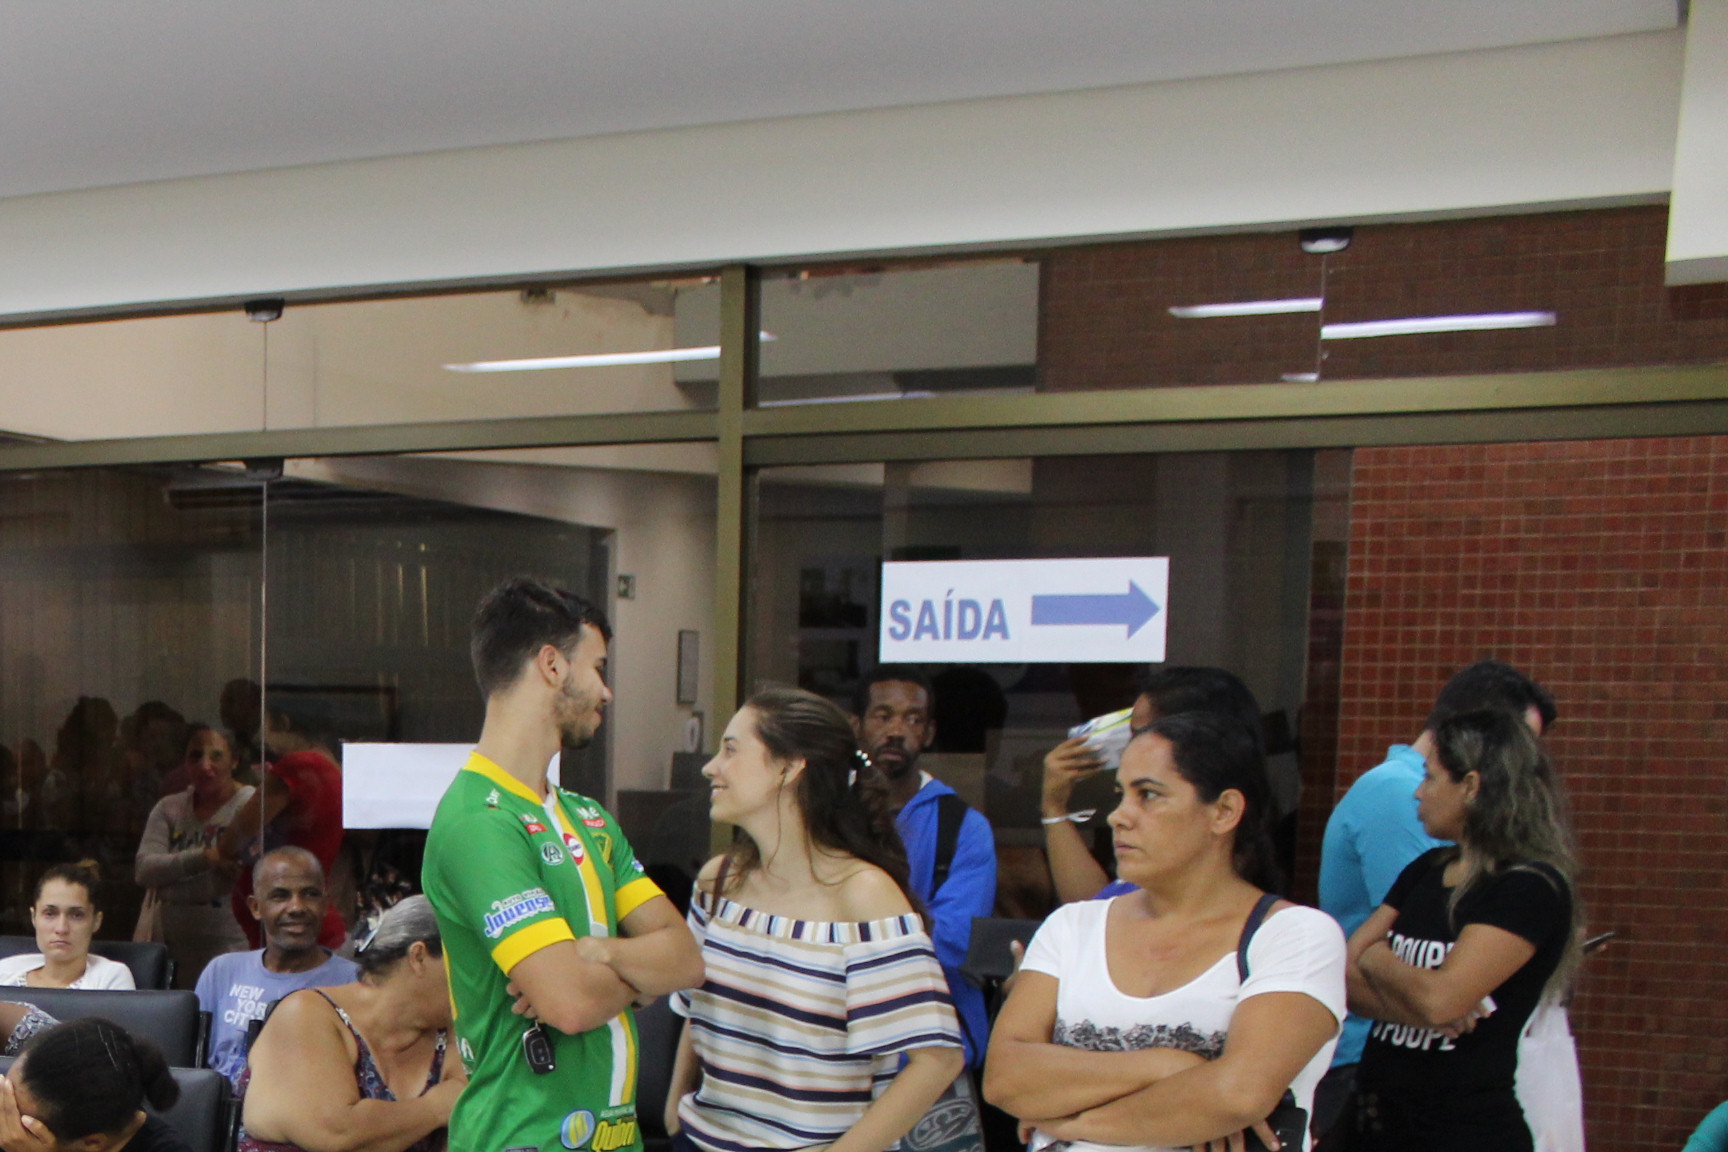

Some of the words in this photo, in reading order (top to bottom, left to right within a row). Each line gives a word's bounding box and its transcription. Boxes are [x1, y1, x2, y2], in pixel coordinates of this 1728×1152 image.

[889, 588, 1010, 641] SAÍDA
[1392, 933, 1455, 970] POUP
[229, 984, 264, 1000] NEW
[238, 999, 268, 1020] YOR
